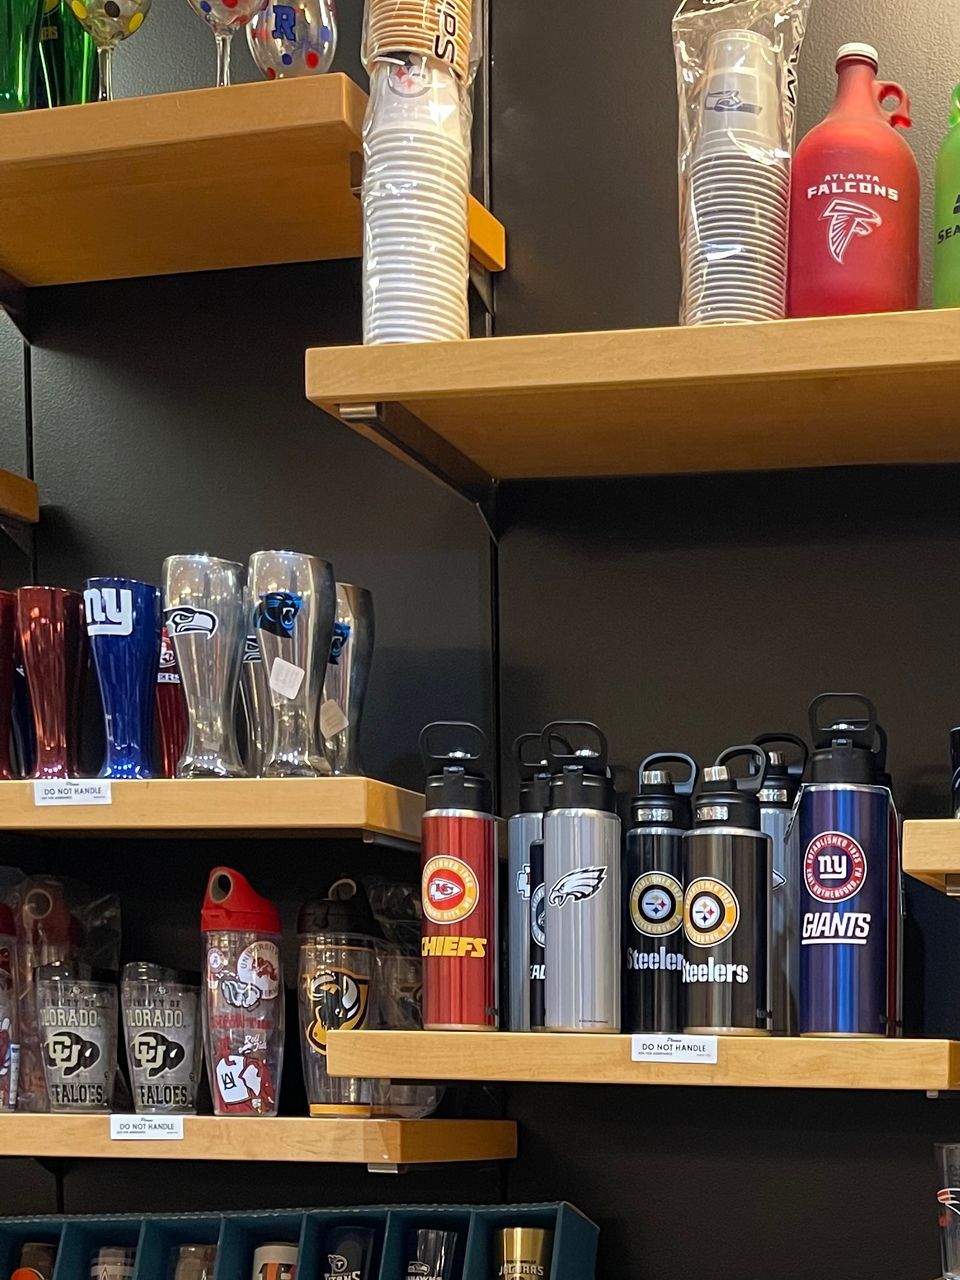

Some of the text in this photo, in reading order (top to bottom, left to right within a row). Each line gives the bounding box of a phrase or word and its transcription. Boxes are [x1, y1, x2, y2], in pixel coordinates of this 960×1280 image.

[273, 4, 297, 41] R
[824, 173, 880, 183] ATLANTA
[807, 182, 899, 201] FALCONS
[84, 588, 133, 636] ny
[74, 787, 101, 795] HANDLE
[818, 855, 847, 879] ny
[802, 912, 872, 938] GIANTS
[627, 946, 684, 970] Steeler
[642, 1043, 706, 1052] DO NOT HANDLE
[498, 1264, 544, 1276] JAGUARS
